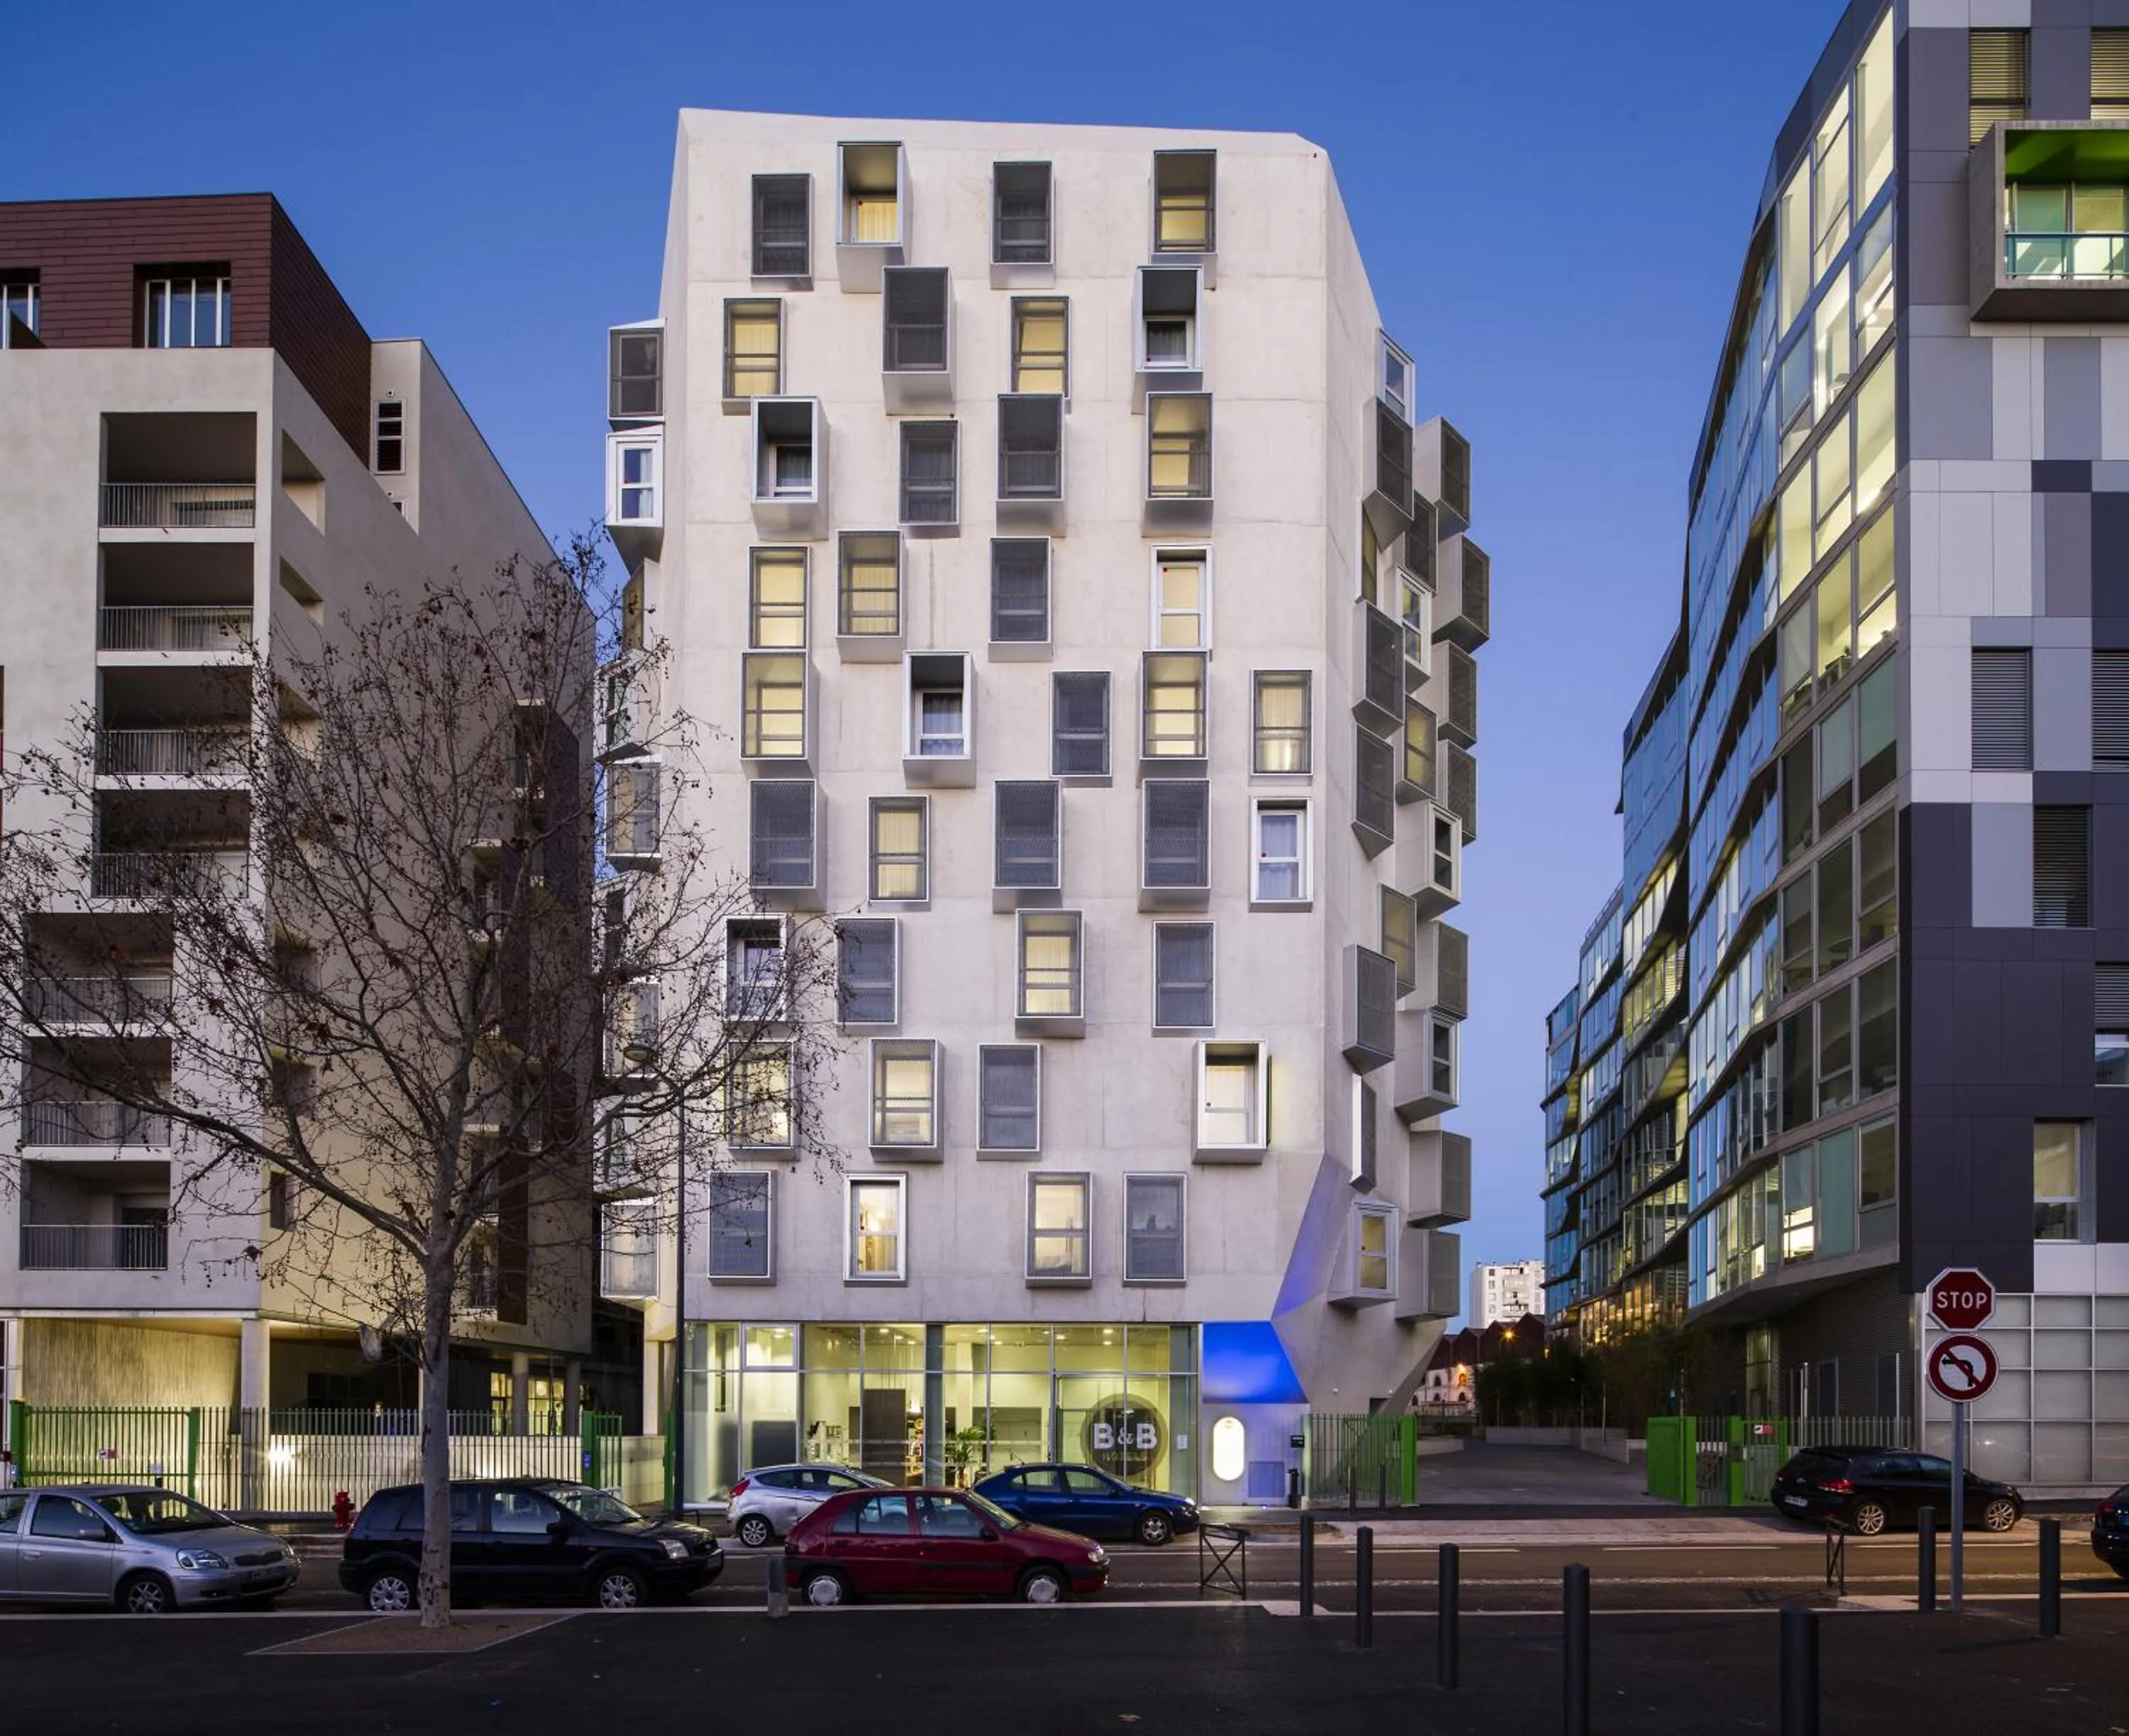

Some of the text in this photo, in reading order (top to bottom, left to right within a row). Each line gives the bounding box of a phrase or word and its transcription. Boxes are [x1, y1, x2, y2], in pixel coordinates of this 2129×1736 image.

[1937, 1291, 1988, 1309] STOP
[1094, 1422, 1157, 1449] B&B
[1102, 1451, 1147, 1461] HOTELS
